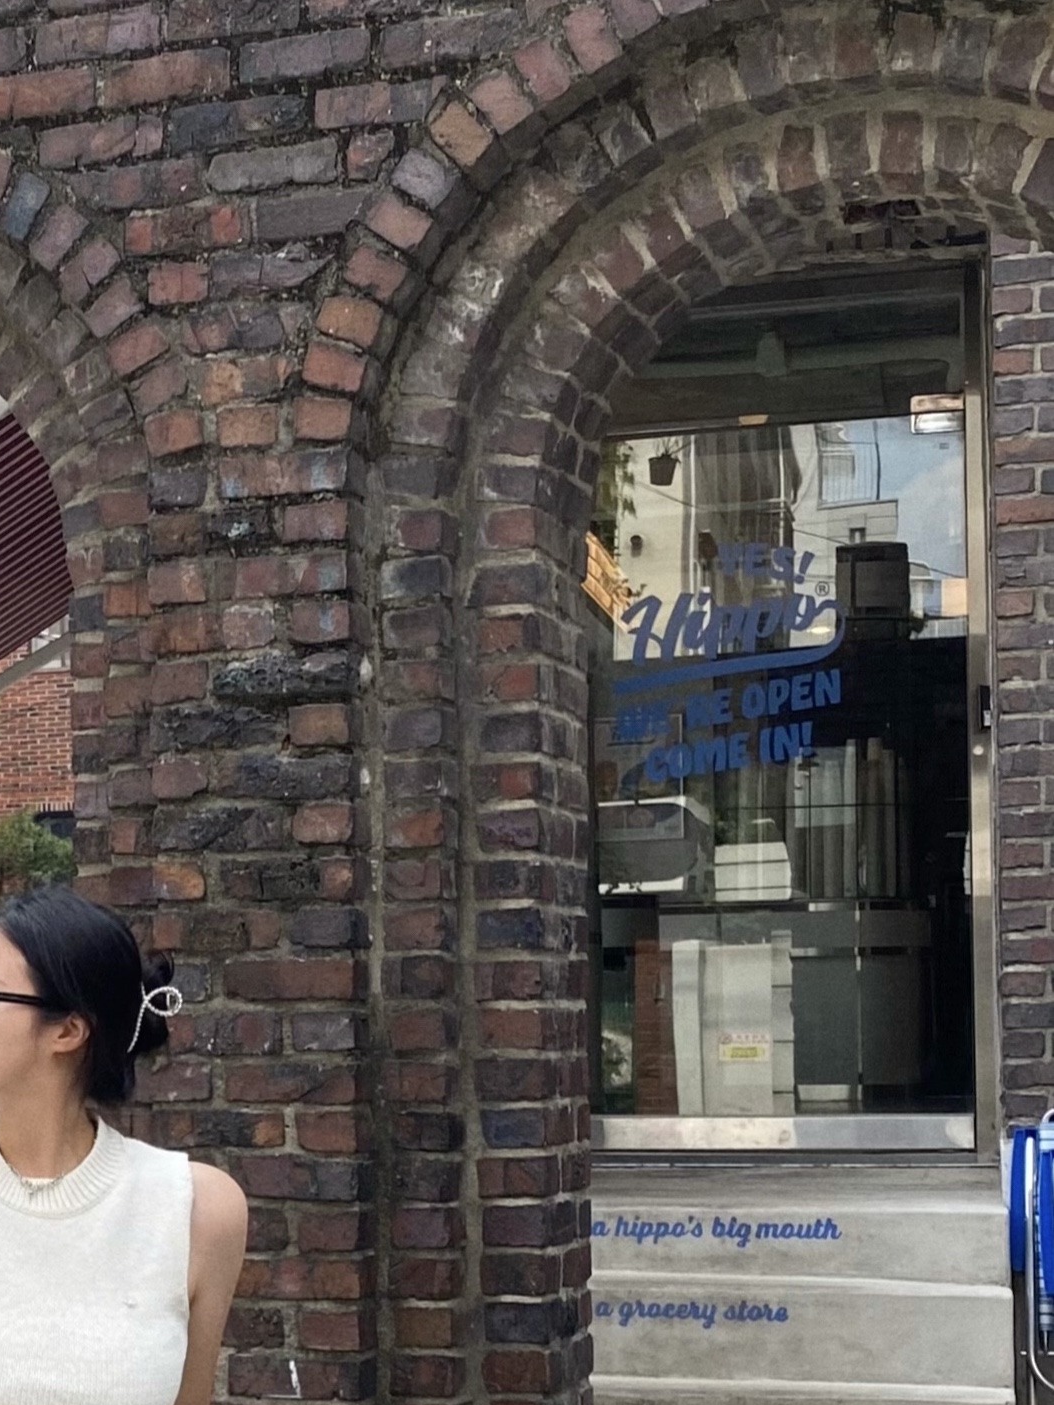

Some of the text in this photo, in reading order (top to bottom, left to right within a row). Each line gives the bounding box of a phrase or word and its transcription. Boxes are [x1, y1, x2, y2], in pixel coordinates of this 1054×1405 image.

[716, 541, 816, 585] YES!
[620, 590, 843, 666] Hippo
[740, 668, 842, 719] OPEN
[644, 731, 751, 783] COME
[759, 721, 814, 764] IN!
[614, 1215, 703, 1244] hippo's
[711, 1216, 751, 1248] big
[754, 1217, 842, 1240] mouth
[596, 1300, 788, 1329] a grocery store
